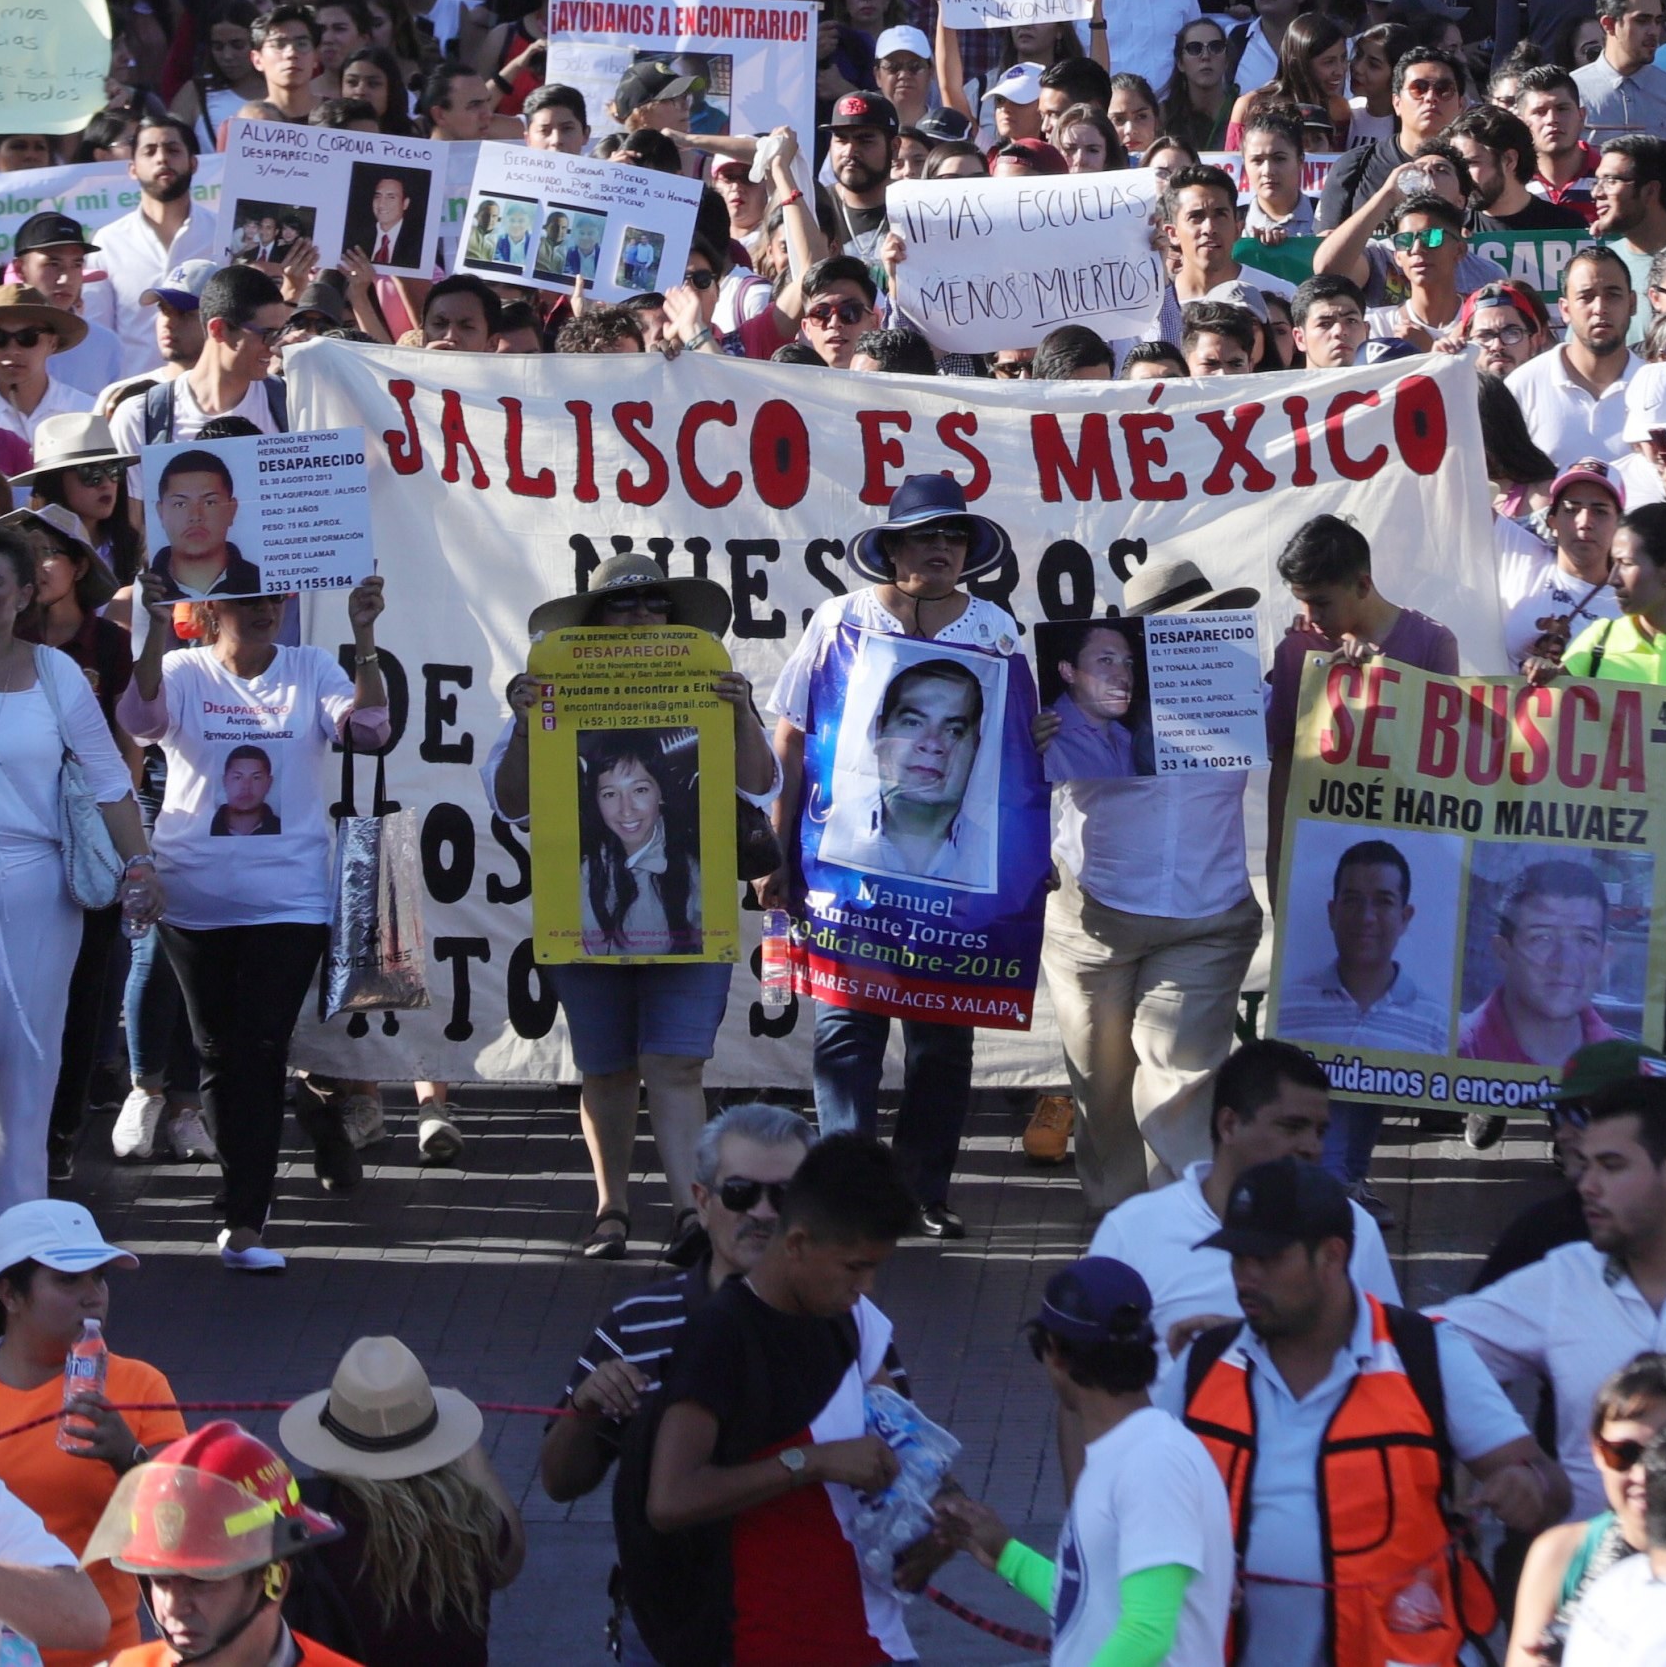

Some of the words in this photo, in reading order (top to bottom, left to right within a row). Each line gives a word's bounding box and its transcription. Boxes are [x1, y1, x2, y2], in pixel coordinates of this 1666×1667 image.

[658, 7, 669, 35] A
[675, 5, 808, 42] ENCONTRARLO!
[15, 86, 80, 102] todos
[240, 123, 309, 148] ALVARO
[317, 134, 374, 154] CORONA
[242, 146, 330, 164] DESAPARECIDO
[503, 151, 556, 171] GERARDO
[566, 160, 605, 177] CORONA
[505, 172, 562, 185] ASESINADO
[571, 178, 591, 190] POR
[600, 184, 638, 196] BUSCAR
[654, 190, 666, 200] SU
[54, 197, 68, 220] y
[75, 191, 108, 210] mi
[903, 190, 993, 244] ¡MÁS
[1017, 184, 1147, 232] ESCUELAS
[920, 276, 1023, 327] MENOS
[1033, 256, 1160, 319] MUERTOS!
[257, 437, 295, 446] ANTONIO
[297, 433, 338, 443] REYNOSO
[382, 377, 811, 509] JALISCO
[857, 407, 989, 507] ES
[1032, 373, 1450, 503] MÉXICO
[257, 446, 310, 456] HERNANDEZ
[259, 453, 364, 472] DESAPARECIDO
[281, 475, 313, 484] AGOSTO
[334, 486, 367, 495] JALISCO
[264, 537, 308, 546] CUALQUIER
[264, 553, 290, 561] FAVOR
[304, 550, 335, 558] LLAMAR
[267, 580, 291, 592] 333
[295, 575, 352, 589] 1155184
[1170, 617, 1188, 625] LUIS
[1189, 616, 1216, 624] ARANA
[1218, 614, 1253, 622] AGUILAR
[560, 634, 586, 642] ERIKA
[586, 633, 628, 641] BERENICE
[629, 633, 660, 641] CUETO
[1150, 628, 1254, 644] DESAPARECIDO
[572, 645, 690, 659] DESAPARECIDA
[663, 661, 682, 669] 2014
[1153, 665, 1163, 673] EN
[1201, 662, 1234, 670] JALISCO
[559, 684, 610, 697] Ayudame
[615, 686, 622, 694] a
[625, 684, 679, 695] encontrar
[564, 700, 719, 713] encontrandoaerika@gmail.com
[579, 716, 617, 728] (+52-1)
[620, 714, 689, 726] 322-183-4519
[1157, 712, 1202, 721] CUALQUIER
[1158, 730, 1183, 738] FAVOR
[1318, 663, 1403, 772] SE
[1417, 683, 1648, 794] BUSCA
[1161, 759, 1177, 770] 33
[1183, 758, 1198, 769] 14
[1203, 755, 1252, 768] 100216
[1308, 775, 1384, 820] JOSÉ
[1392, 788, 1483, 833] HARO
[1494, 796, 1650, 846] MALVAEZ
[857, 880, 953, 918] Manuel
[813, 905, 903, 936] Amante
[906, 918, 988, 950] Torres
[864, 982, 946, 1010] ENLACES
[951, 996, 1020, 1017] XALAPA
[1431, 1078, 1449, 1100] a
